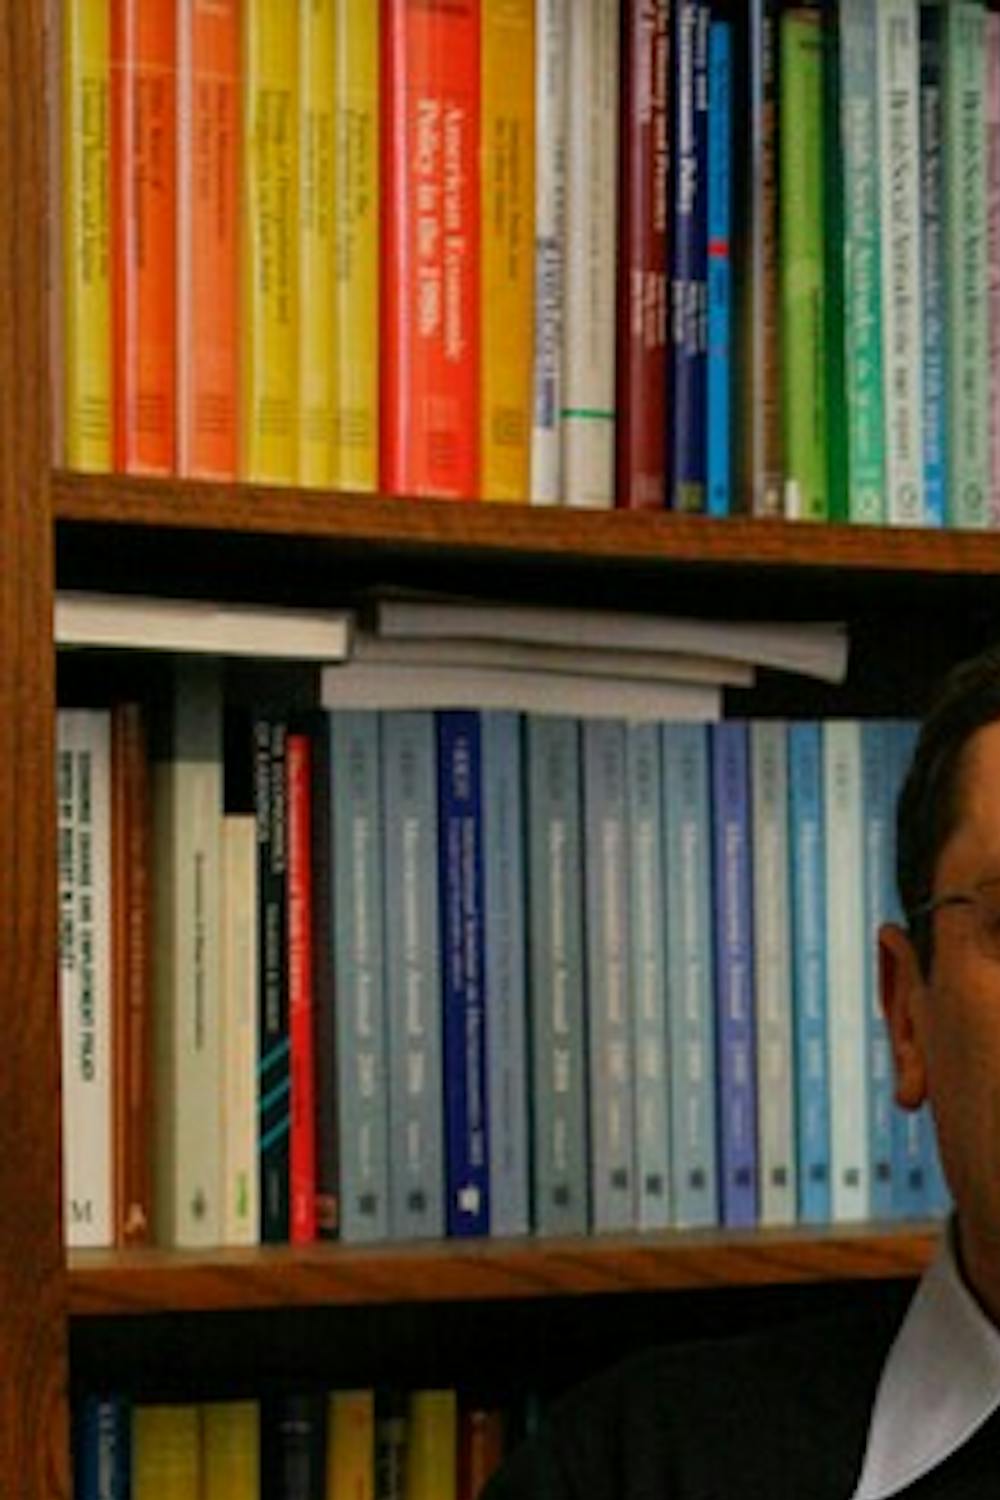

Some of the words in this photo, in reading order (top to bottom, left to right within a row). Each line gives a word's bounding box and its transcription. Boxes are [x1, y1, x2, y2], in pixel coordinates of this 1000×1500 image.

[695, 74, 708, 111] and
[890, 90, 911, 154] British
[961, 91, 981, 158] British
[414, 99, 441, 173] Policy
[653, 114, 668, 145] and
[849, 100, 873, 171] British
[414, 184, 441, 210] in
[443, 105, 466, 230] American
[677, 157, 696, 215] Policy
[890, 160, 912, 224] Social
[962, 162, 982, 229] Social
[414, 216, 441, 258] the
[851, 176, 874, 239] Social
[414, 266, 441, 338] 1980s
[443, 236, 466, 361] Economic
[256, 722, 270, 746] OF
[270, 727, 286, 758] THE
[79, 751, 93, 823] ECONOMIC
[256, 752, 270, 843] EARNINGS
[270, 763, 286, 874] ECONOMICS
[59, 826, 74, 883] ROBERT
[79, 831, 93, 887] CHANGE
[79, 930, 93, 1026] EMPLOYMENT
[79, 1030, 93, 1083] POLICY
